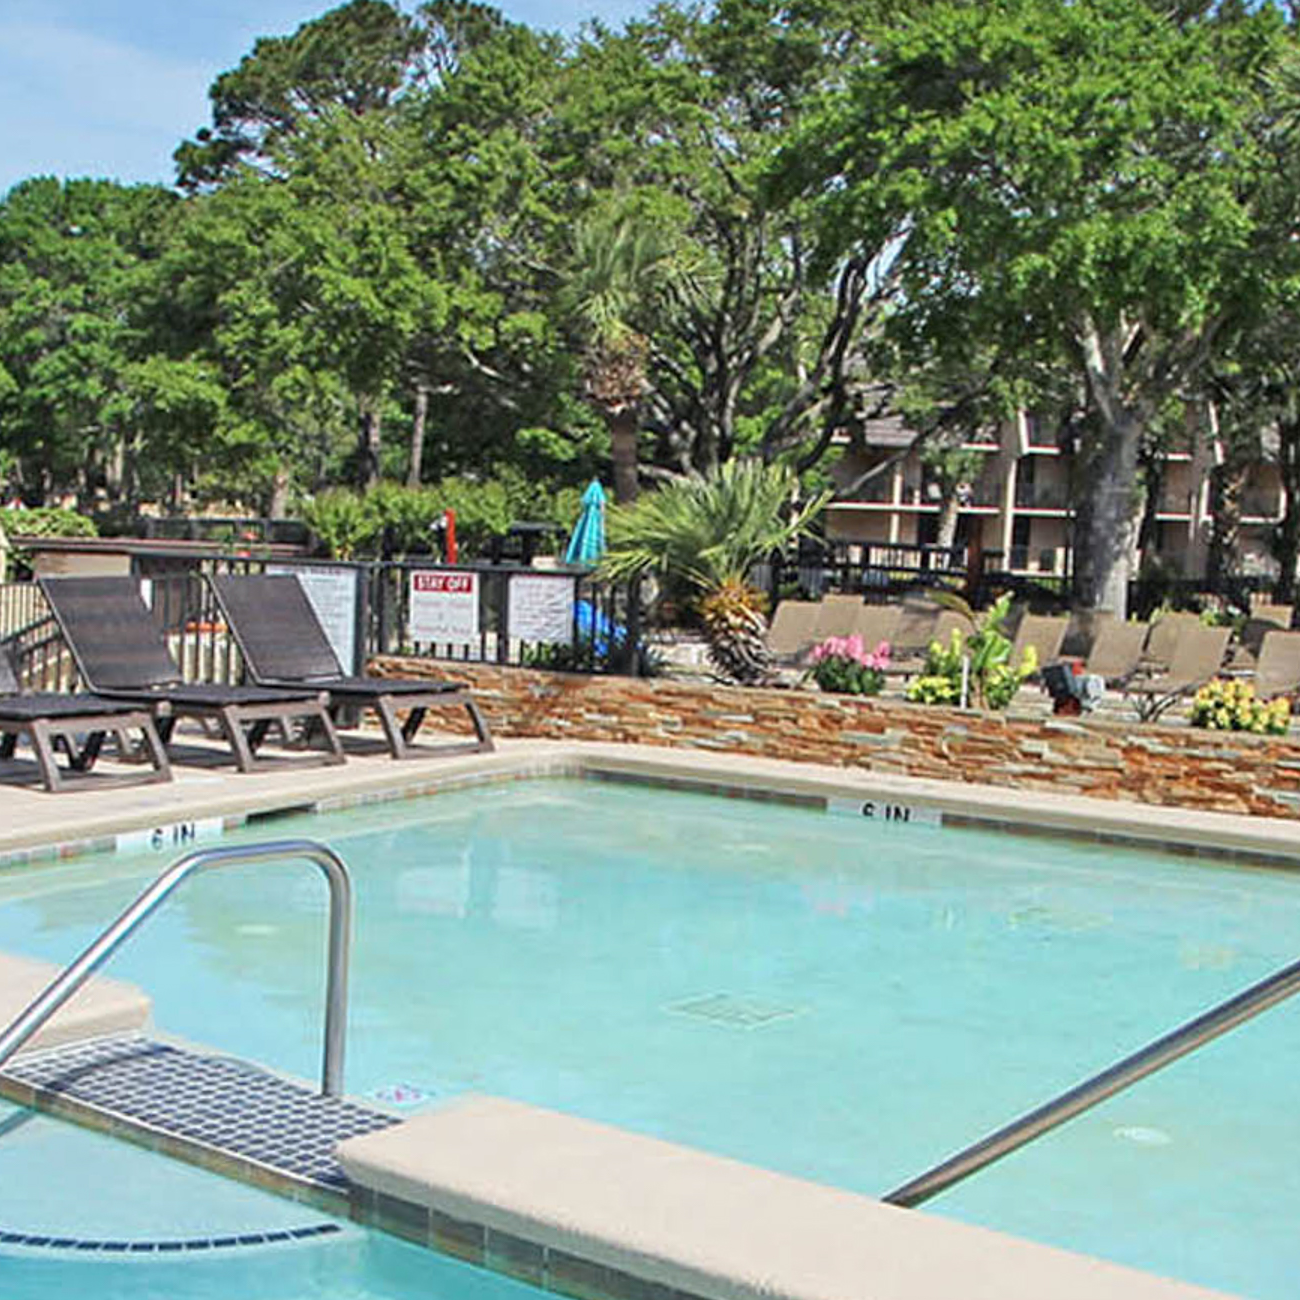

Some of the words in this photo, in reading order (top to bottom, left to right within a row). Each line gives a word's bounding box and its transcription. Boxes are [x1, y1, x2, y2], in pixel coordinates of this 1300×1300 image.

[417, 574, 444, 591] STAY
[445, 575, 471, 592] OFF
[885, 804, 911, 823] IN
[151, 827, 164, 851] 6
[172, 822, 195, 846] IN
